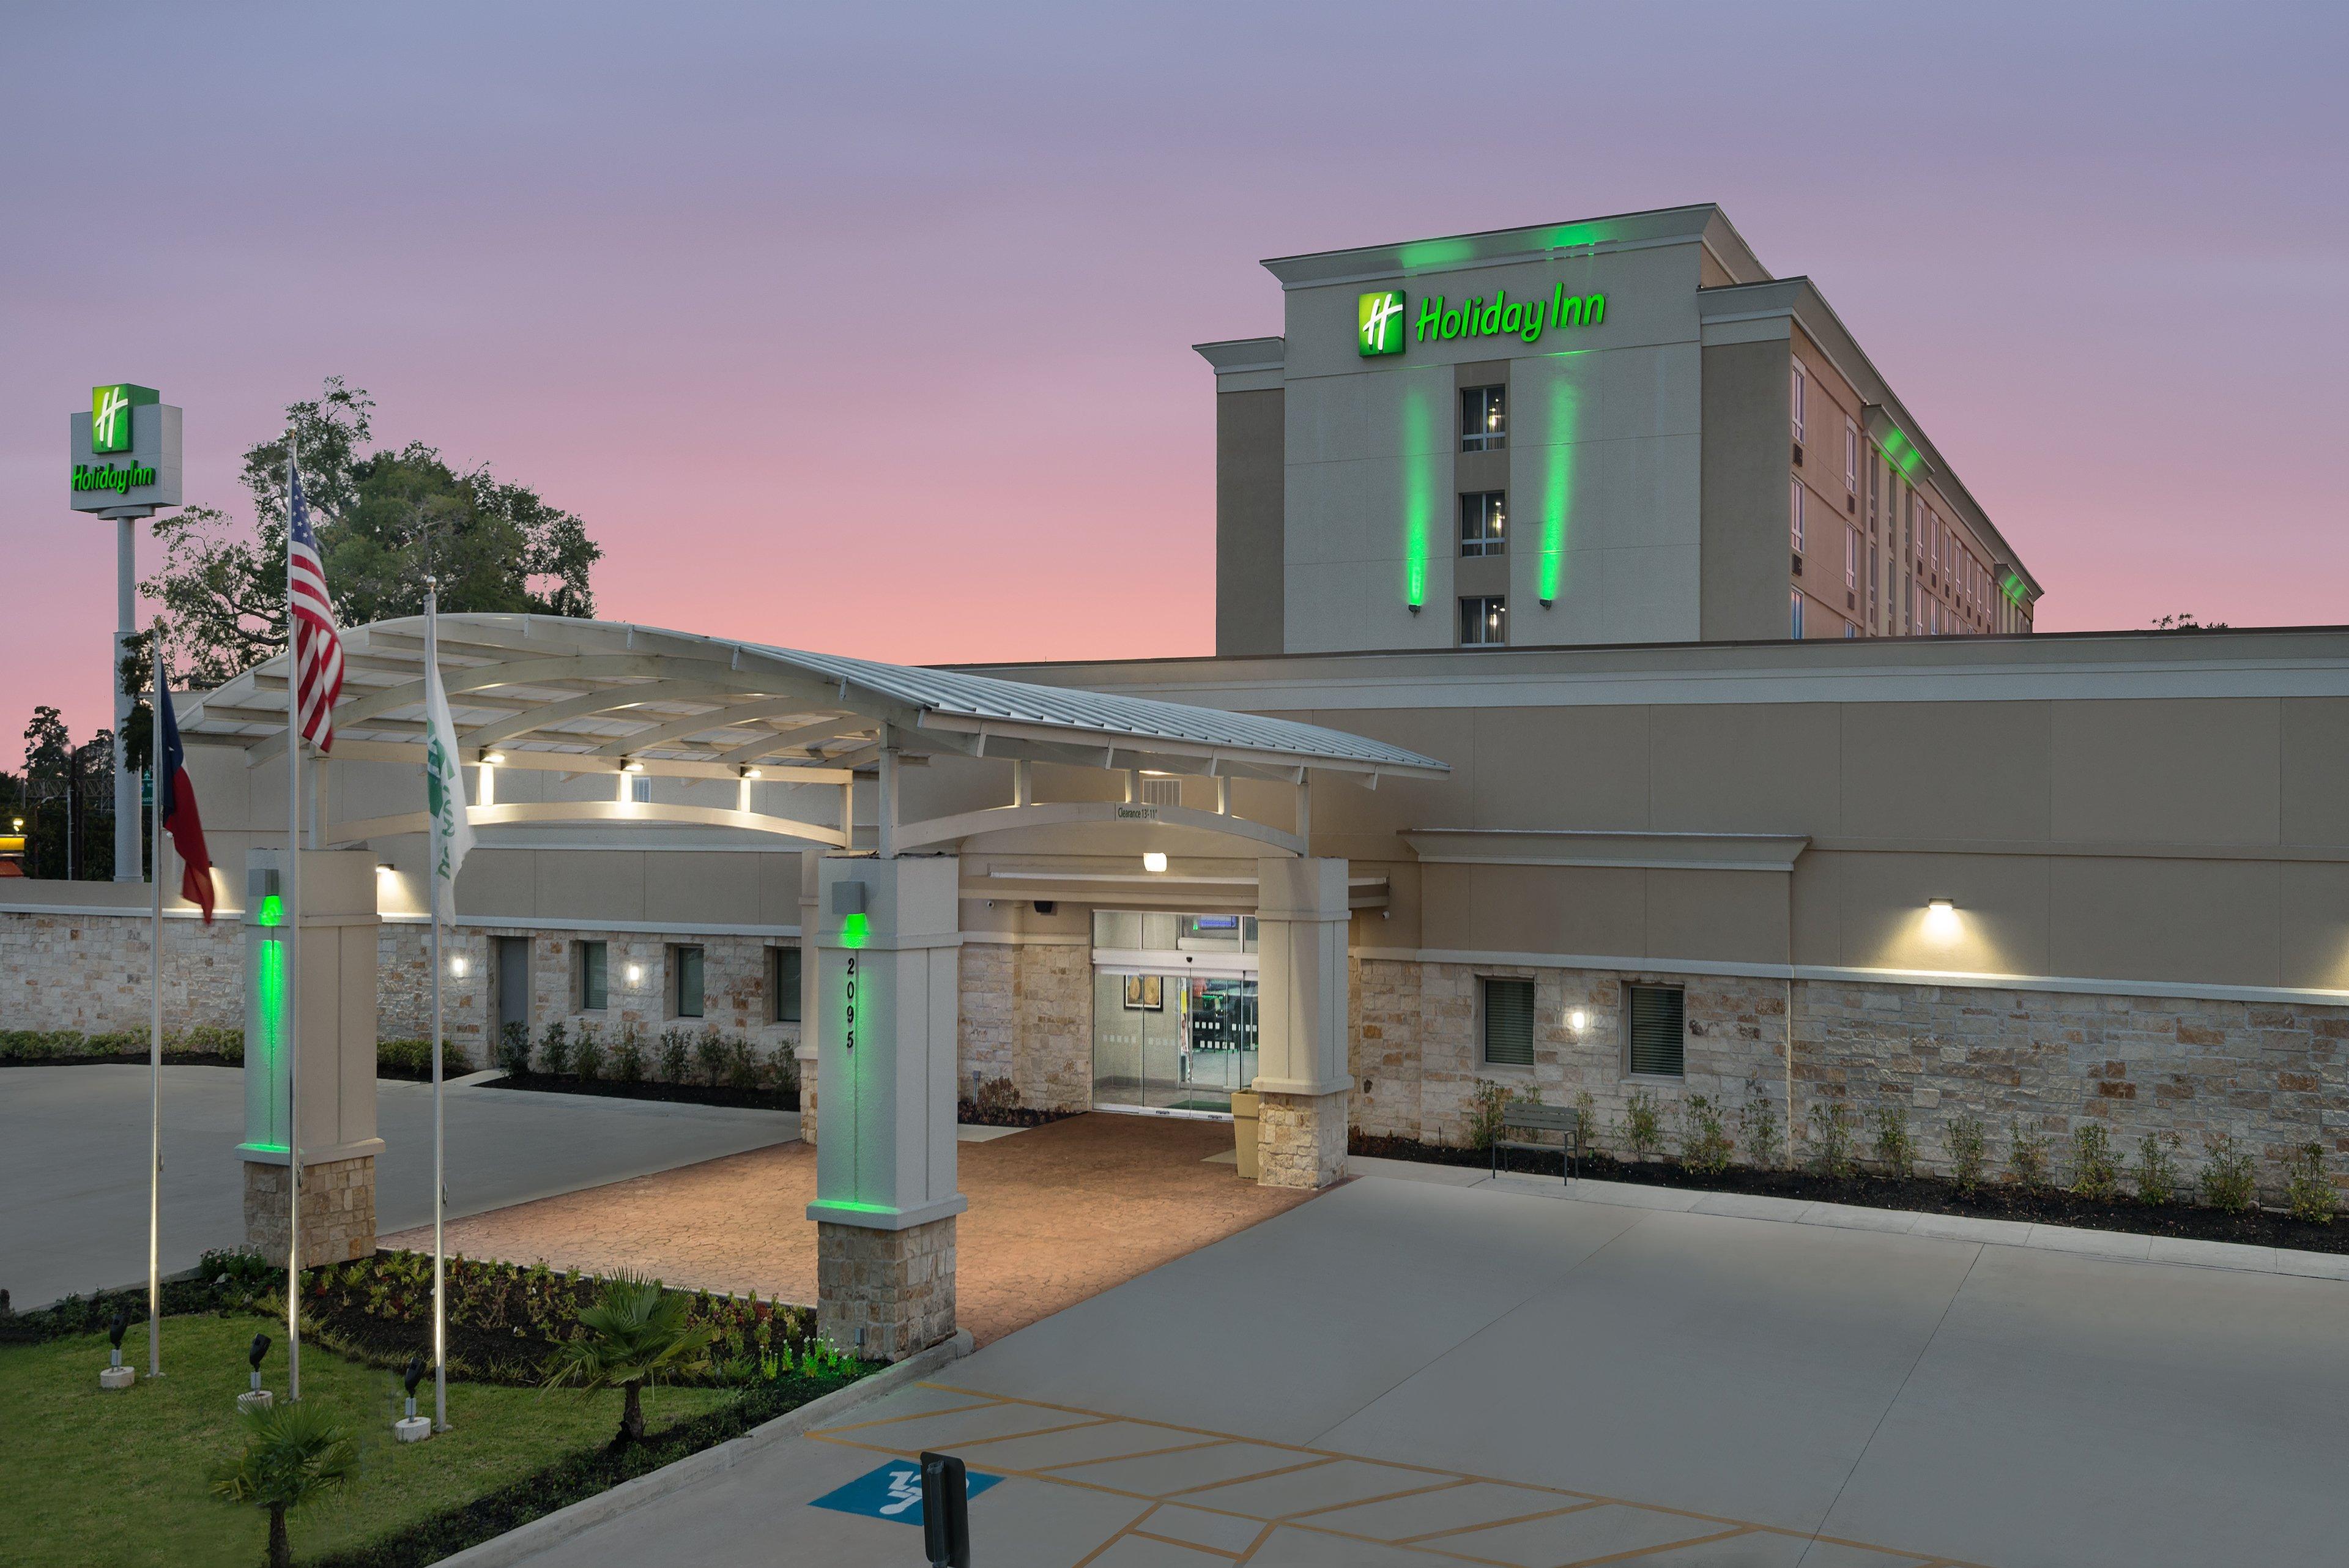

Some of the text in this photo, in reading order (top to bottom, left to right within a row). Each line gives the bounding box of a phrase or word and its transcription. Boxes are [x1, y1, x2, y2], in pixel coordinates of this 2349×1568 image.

[1362, 294, 1403, 350] H
[1416, 281, 1606, 342] Holiday Inn
[95, 387, 128, 448] H
[72, 459, 155, 494] Holiday Inn
[1118, 807, 1141, 819] Clearance
